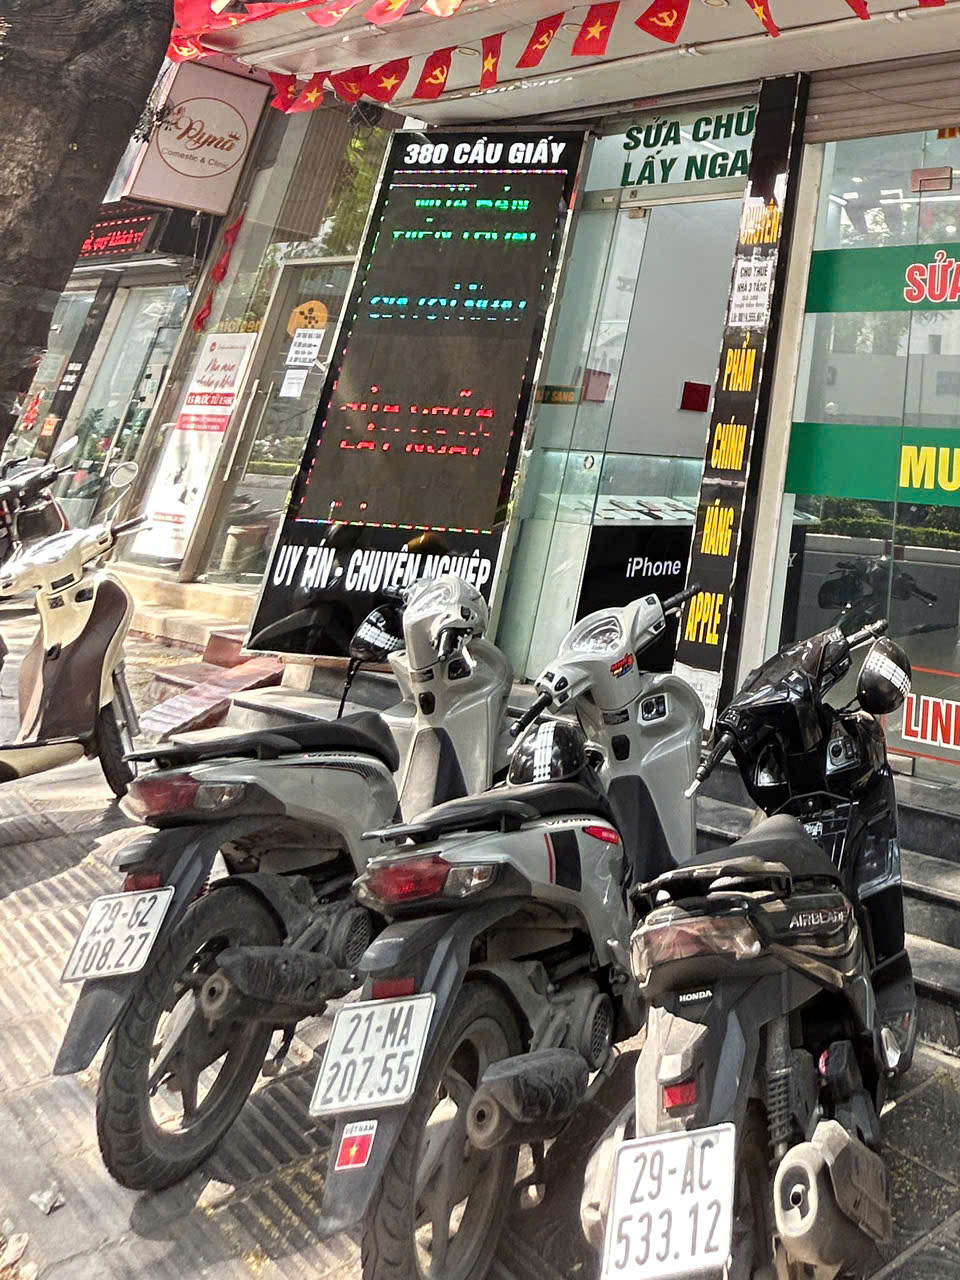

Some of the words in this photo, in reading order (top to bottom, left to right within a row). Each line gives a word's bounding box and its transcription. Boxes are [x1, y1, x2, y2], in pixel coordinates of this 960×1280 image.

[403, 143, 449, 165] 380
[453, 136, 503, 165] CẦU
[508, 136, 567, 165] GIẤY
[621, 149, 678, 187] LẤY
[273, 545, 303, 587] UY
[344, 544, 421, 593] CHUYÊN
[625, 555, 683, 579] iPhone
[684, 591, 724, 646] APPLE
[69, 933, 150, 976] 108.27
[679, 988, 713, 1002] HONDA
[341, 1004, 415, 1054] 21-MA
[321, 1049, 415, 1107] 207.55
[629, 1138, 716, 1205] 29-AC
[613, 1198, 722, 1270] 533.12
